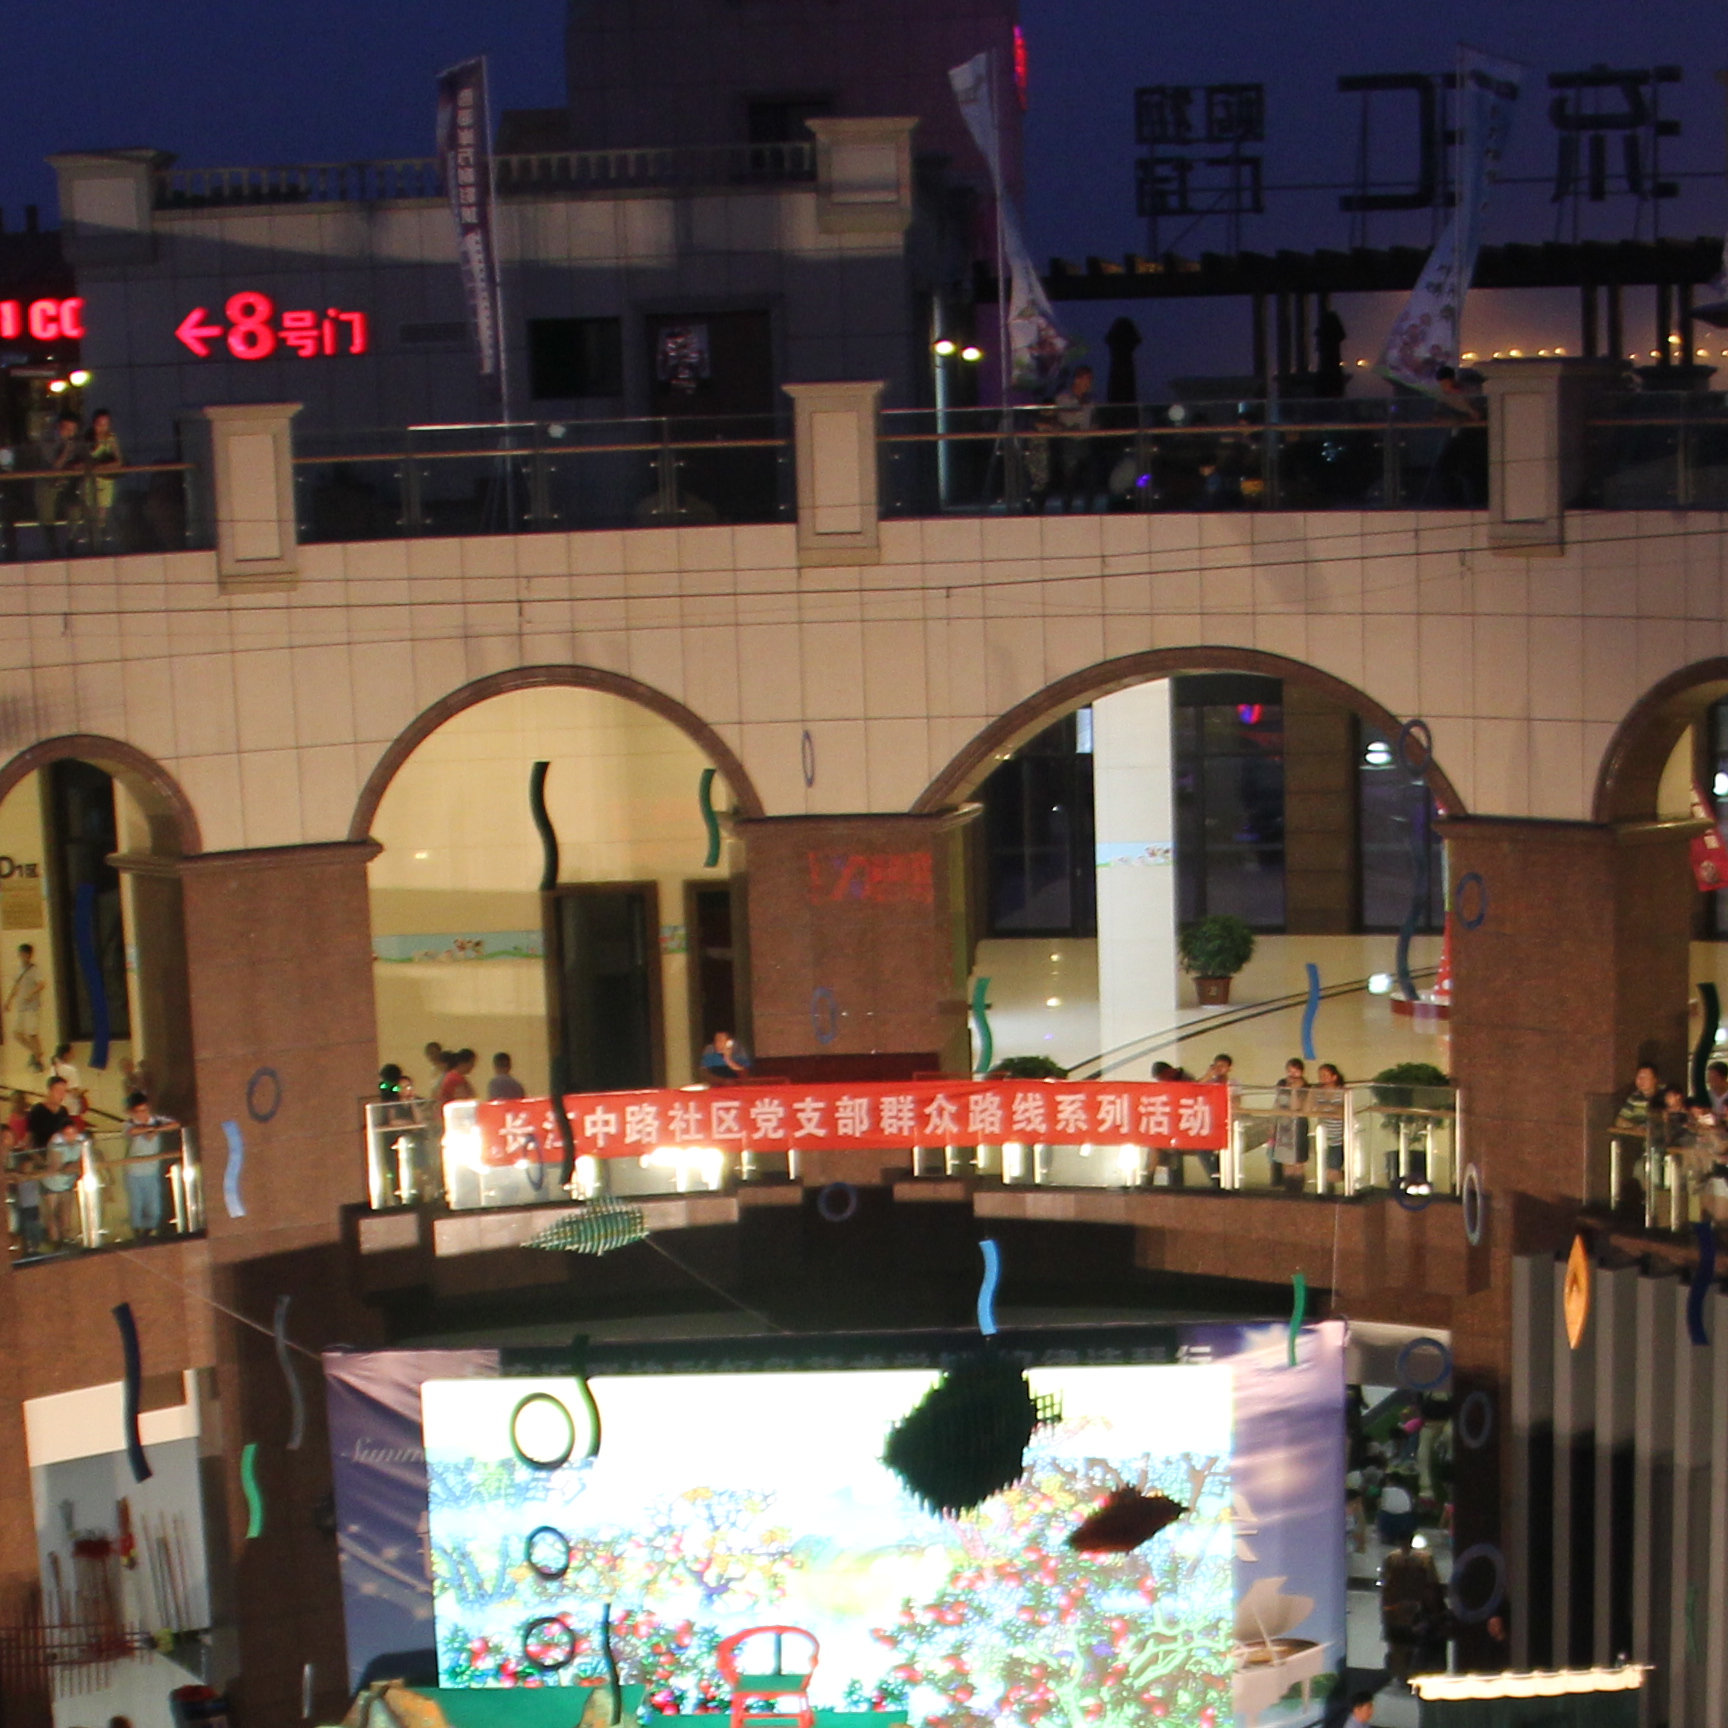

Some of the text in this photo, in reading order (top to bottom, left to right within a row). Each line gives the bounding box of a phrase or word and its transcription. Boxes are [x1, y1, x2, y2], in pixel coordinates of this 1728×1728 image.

[225, 291, 369, 361] 8号门
[498, 1091, 1213, 1155] 长江中路社区党支部群众路线系列活动
